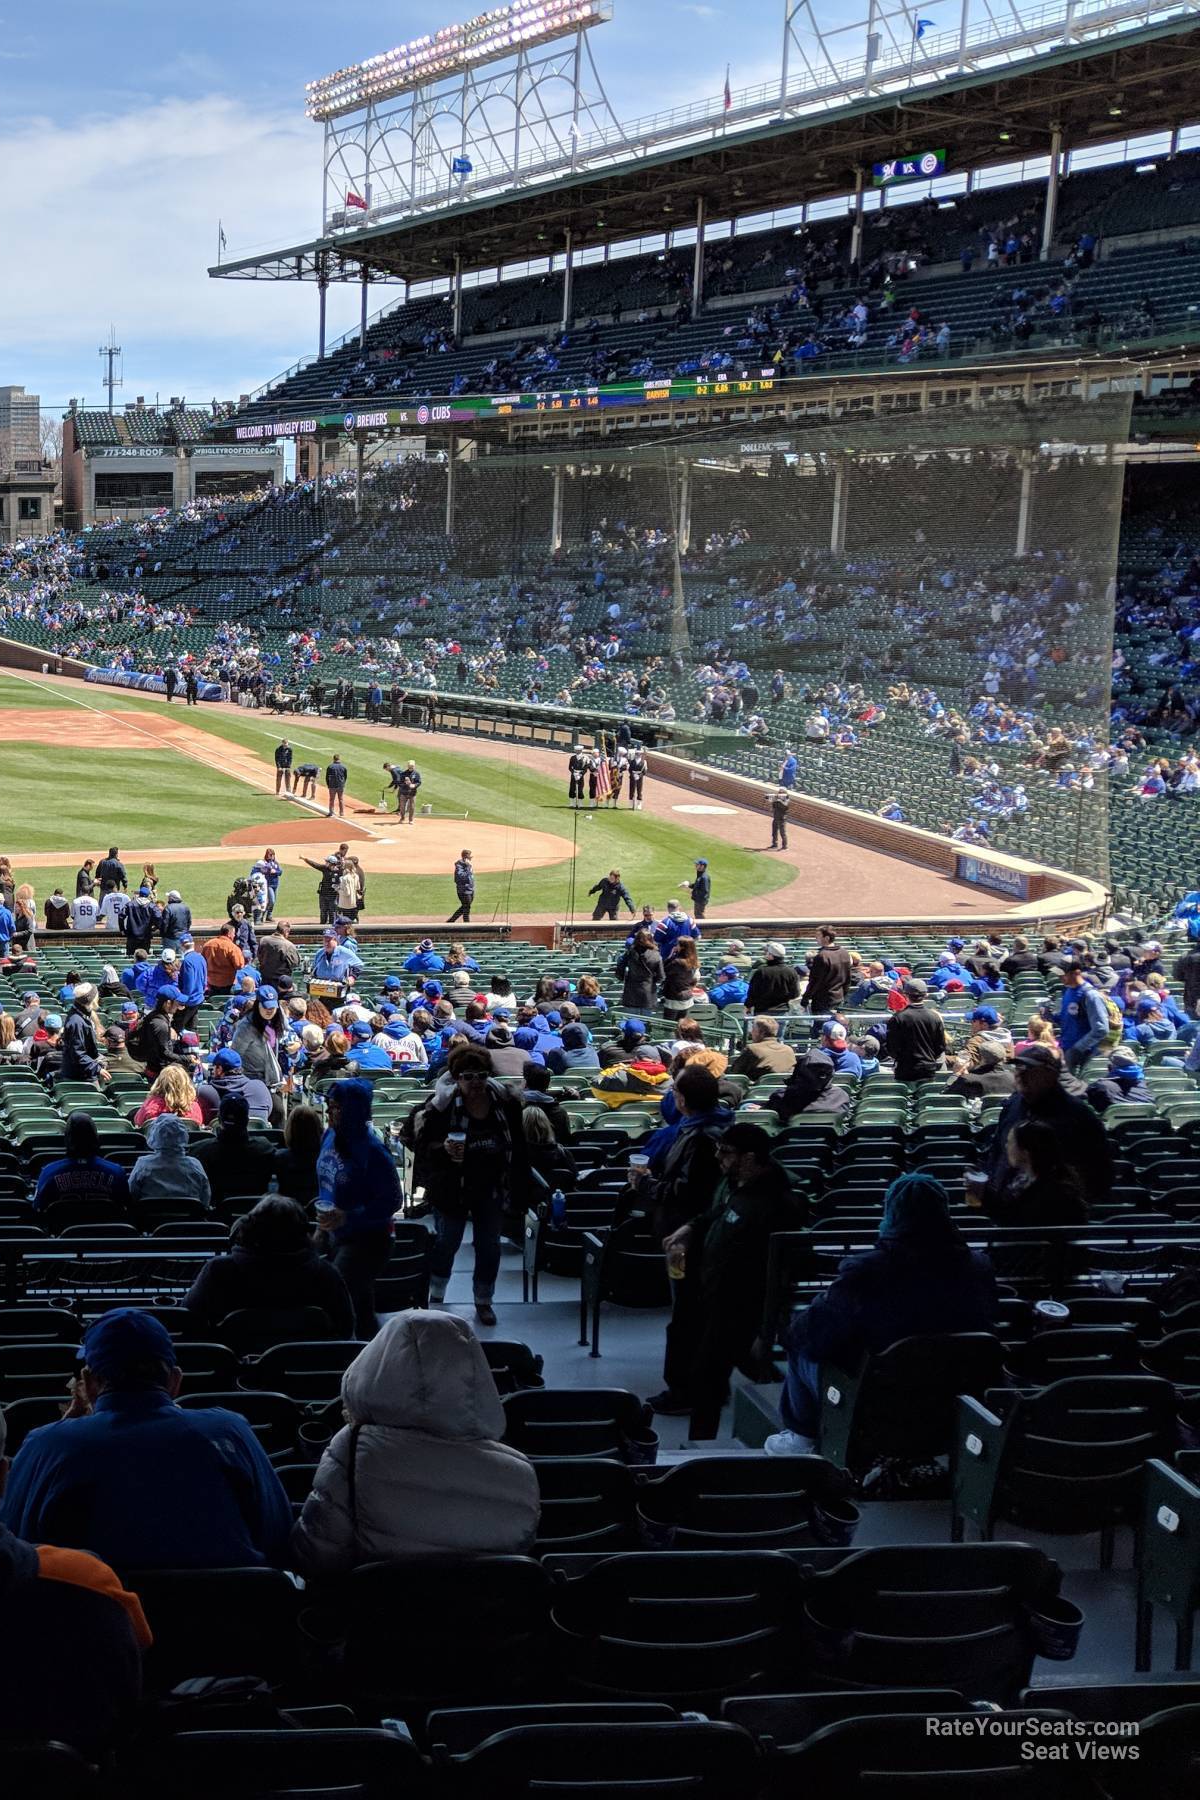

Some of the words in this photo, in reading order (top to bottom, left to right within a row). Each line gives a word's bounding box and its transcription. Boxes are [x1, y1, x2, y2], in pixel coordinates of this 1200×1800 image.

[357, 412, 388, 428] BREWERS
[432, 405, 451, 420] CUBS
[236, 424, 264, 439] WELCOME
[264, 423, 273, 435] TO
[273, 421, 299, 435] WRIGLEY
[300, 419, 316, 433] FIELD
[103, 448, 164, 457] 773-248-ROOF
[80, 905, 93, 916] 69
